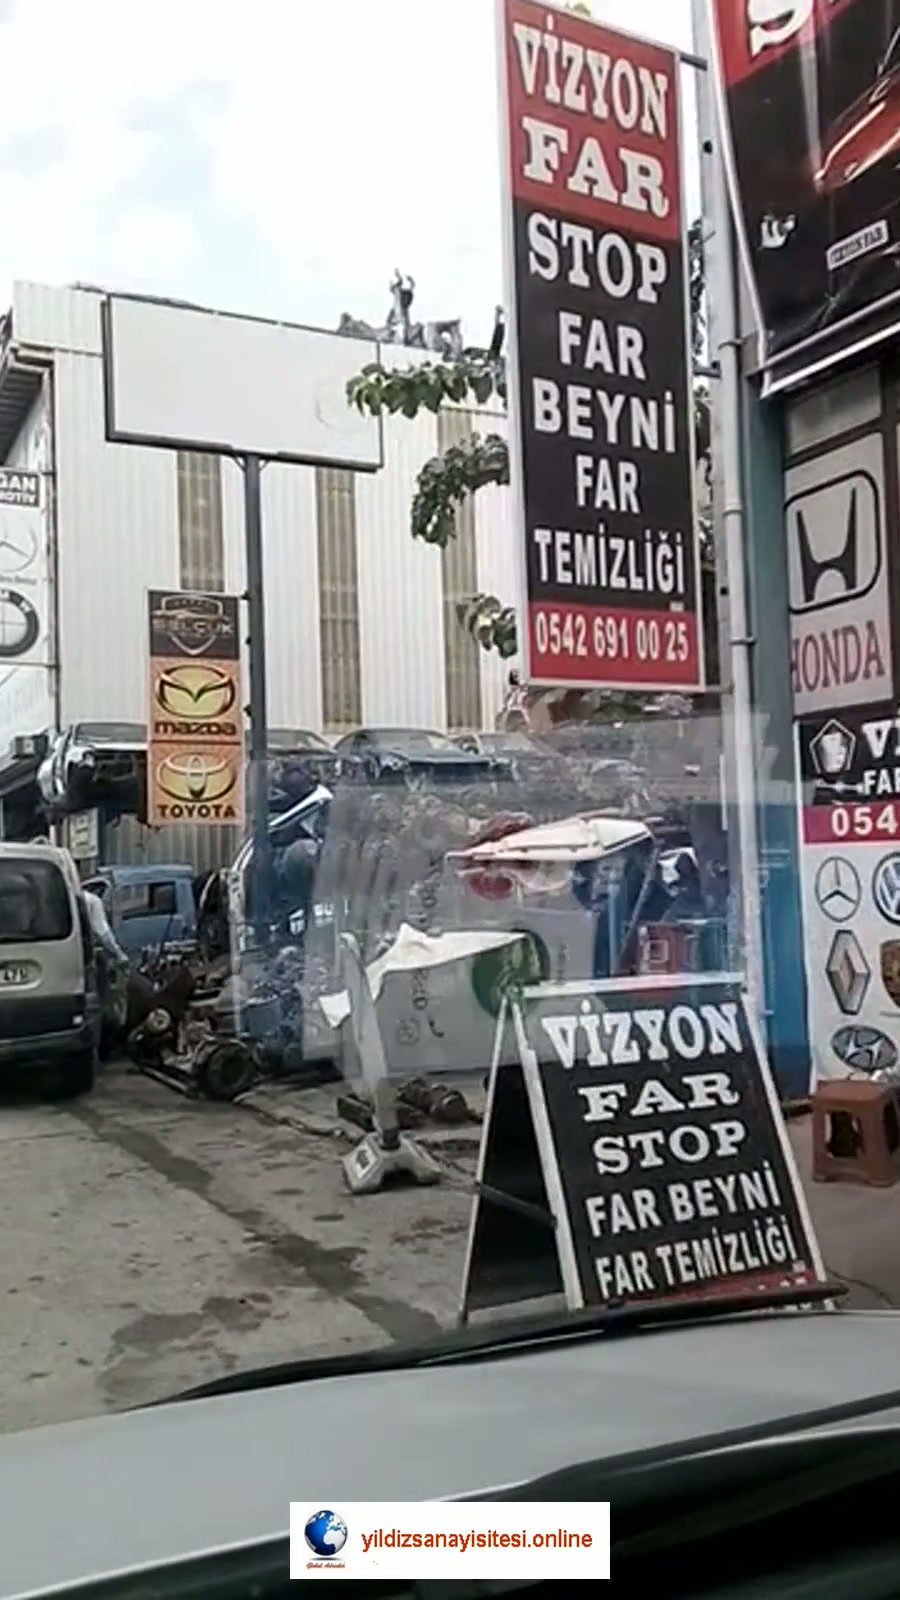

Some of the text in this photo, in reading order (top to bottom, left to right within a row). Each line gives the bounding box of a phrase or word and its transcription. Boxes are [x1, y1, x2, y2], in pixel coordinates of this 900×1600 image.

[513, 14, 668, 140] VİZYON
[521, 116, 669, 218] FAR
[528, 212, 667, 304] STOP
[559, 311, 646, 380] FAR
[532, 377, 676, 454] BEYNİ
[576, 454, 640, 514] FAR
[534, 526, 685, 594] TEMİZLİĞİ
[535, 611, 689, 662] 0542 691 00 25
[157, 803, 237, 818] TOYOTA
[541, 1000, 743, 1070] VİZYON
[577, 1071, 741, 1123] FAR
[593, 1120, 746, 1175] STOP
[585, 1159, 782, 1239] FAR BEYNİ
[595, 1250, 656, 1300] FAR
[655, 1214, 798, 1288] TEMİZLİĞİ
